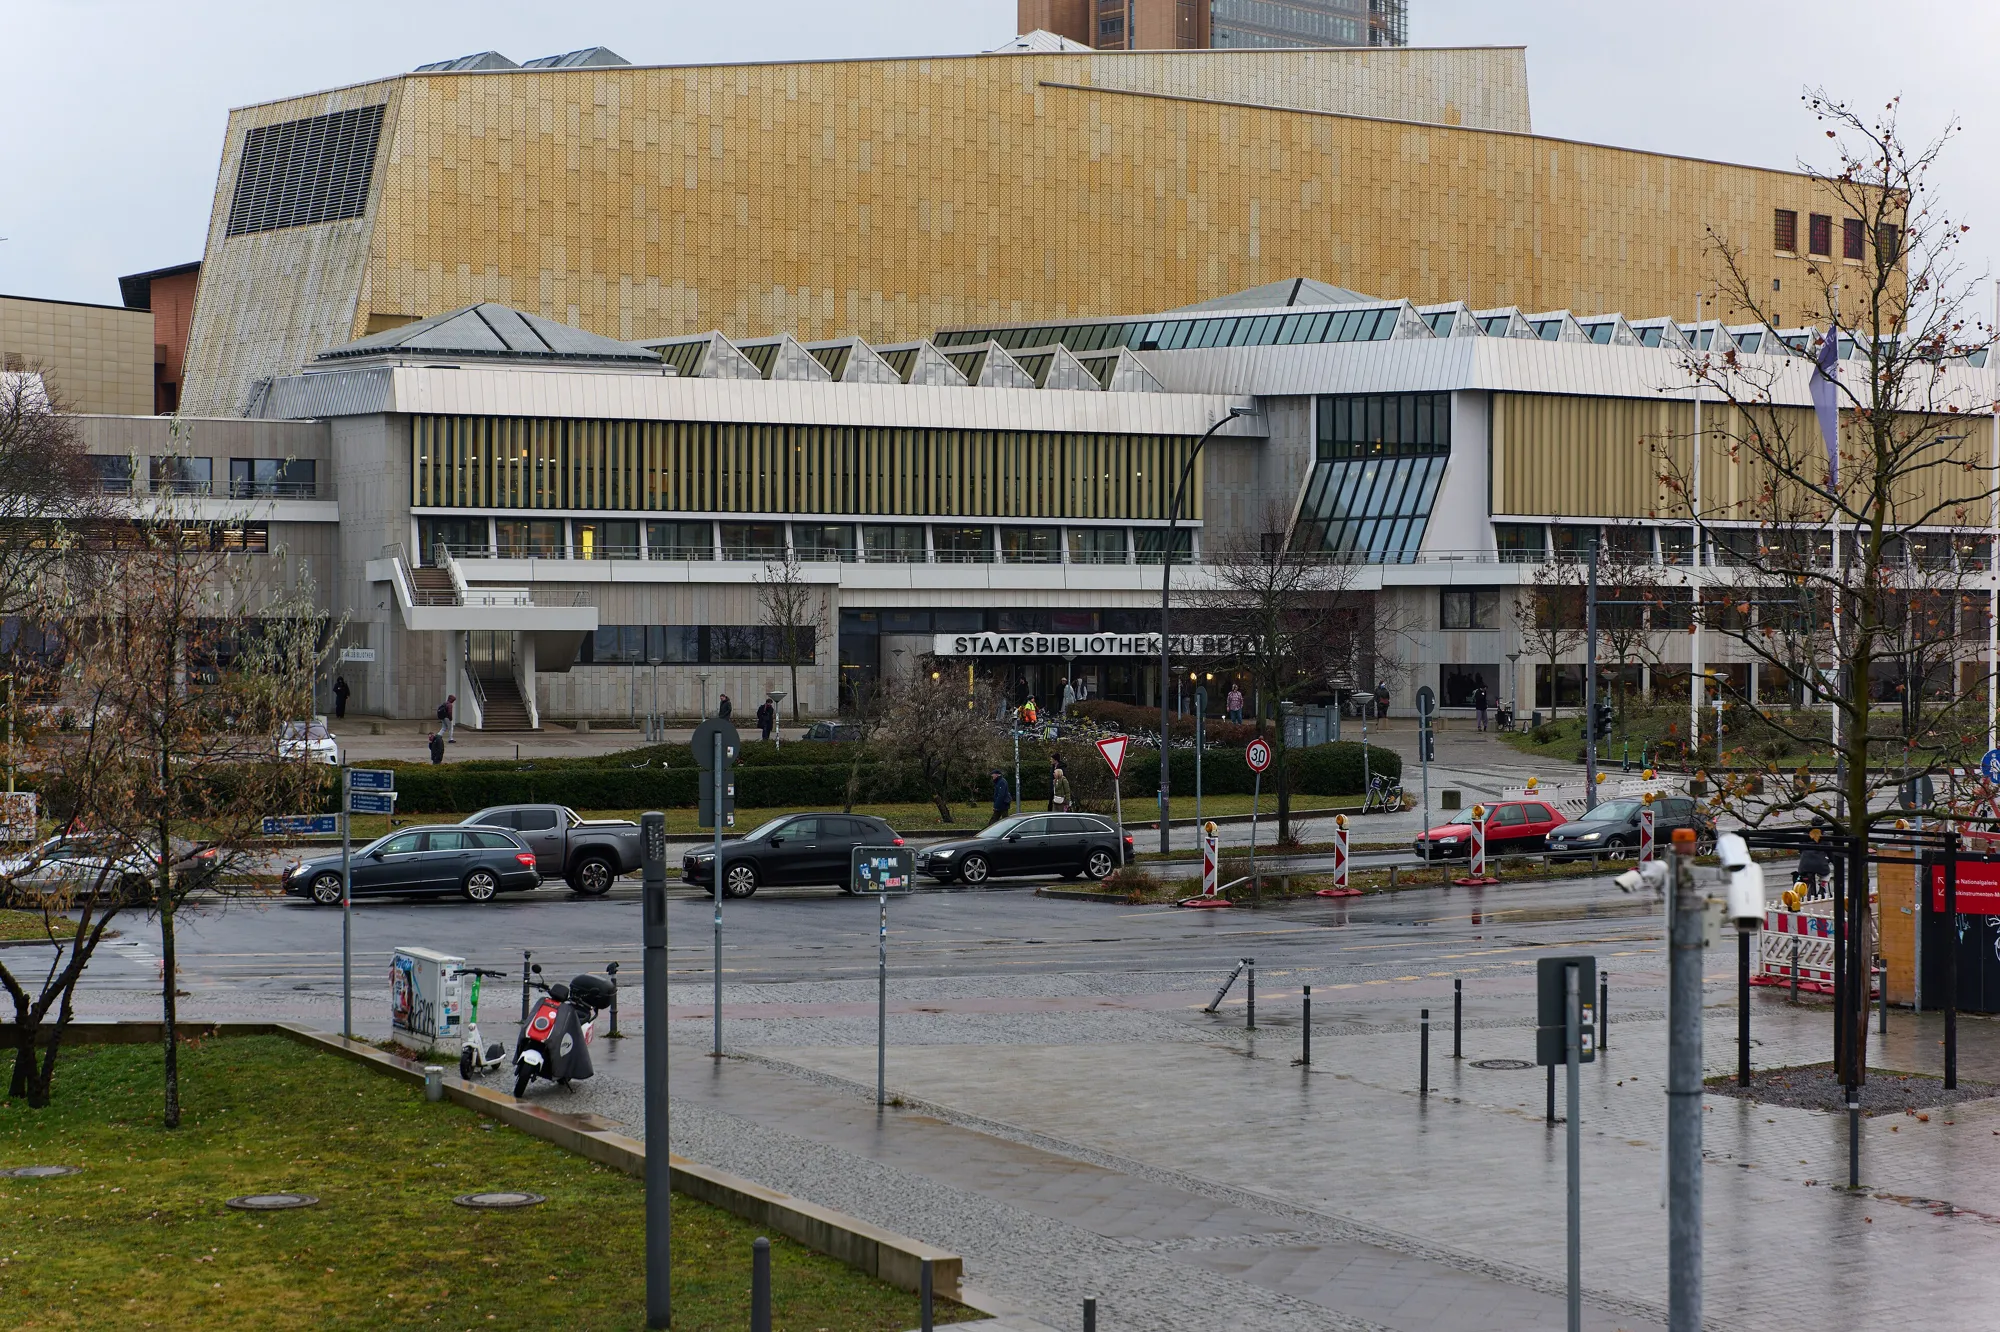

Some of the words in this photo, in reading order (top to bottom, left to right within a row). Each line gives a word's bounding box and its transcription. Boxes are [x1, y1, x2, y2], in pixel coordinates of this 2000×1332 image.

[955, 637, 1162, 653] STAATSBIBLIOTHEK
[1168, 637, 1194, 654] ZU
[1251, 747, 1266, 764] 30
[1960, 878, 1998, 886] Nationalgalerie
[1955, 889, 2000, 898] sikinstrumenten-M
